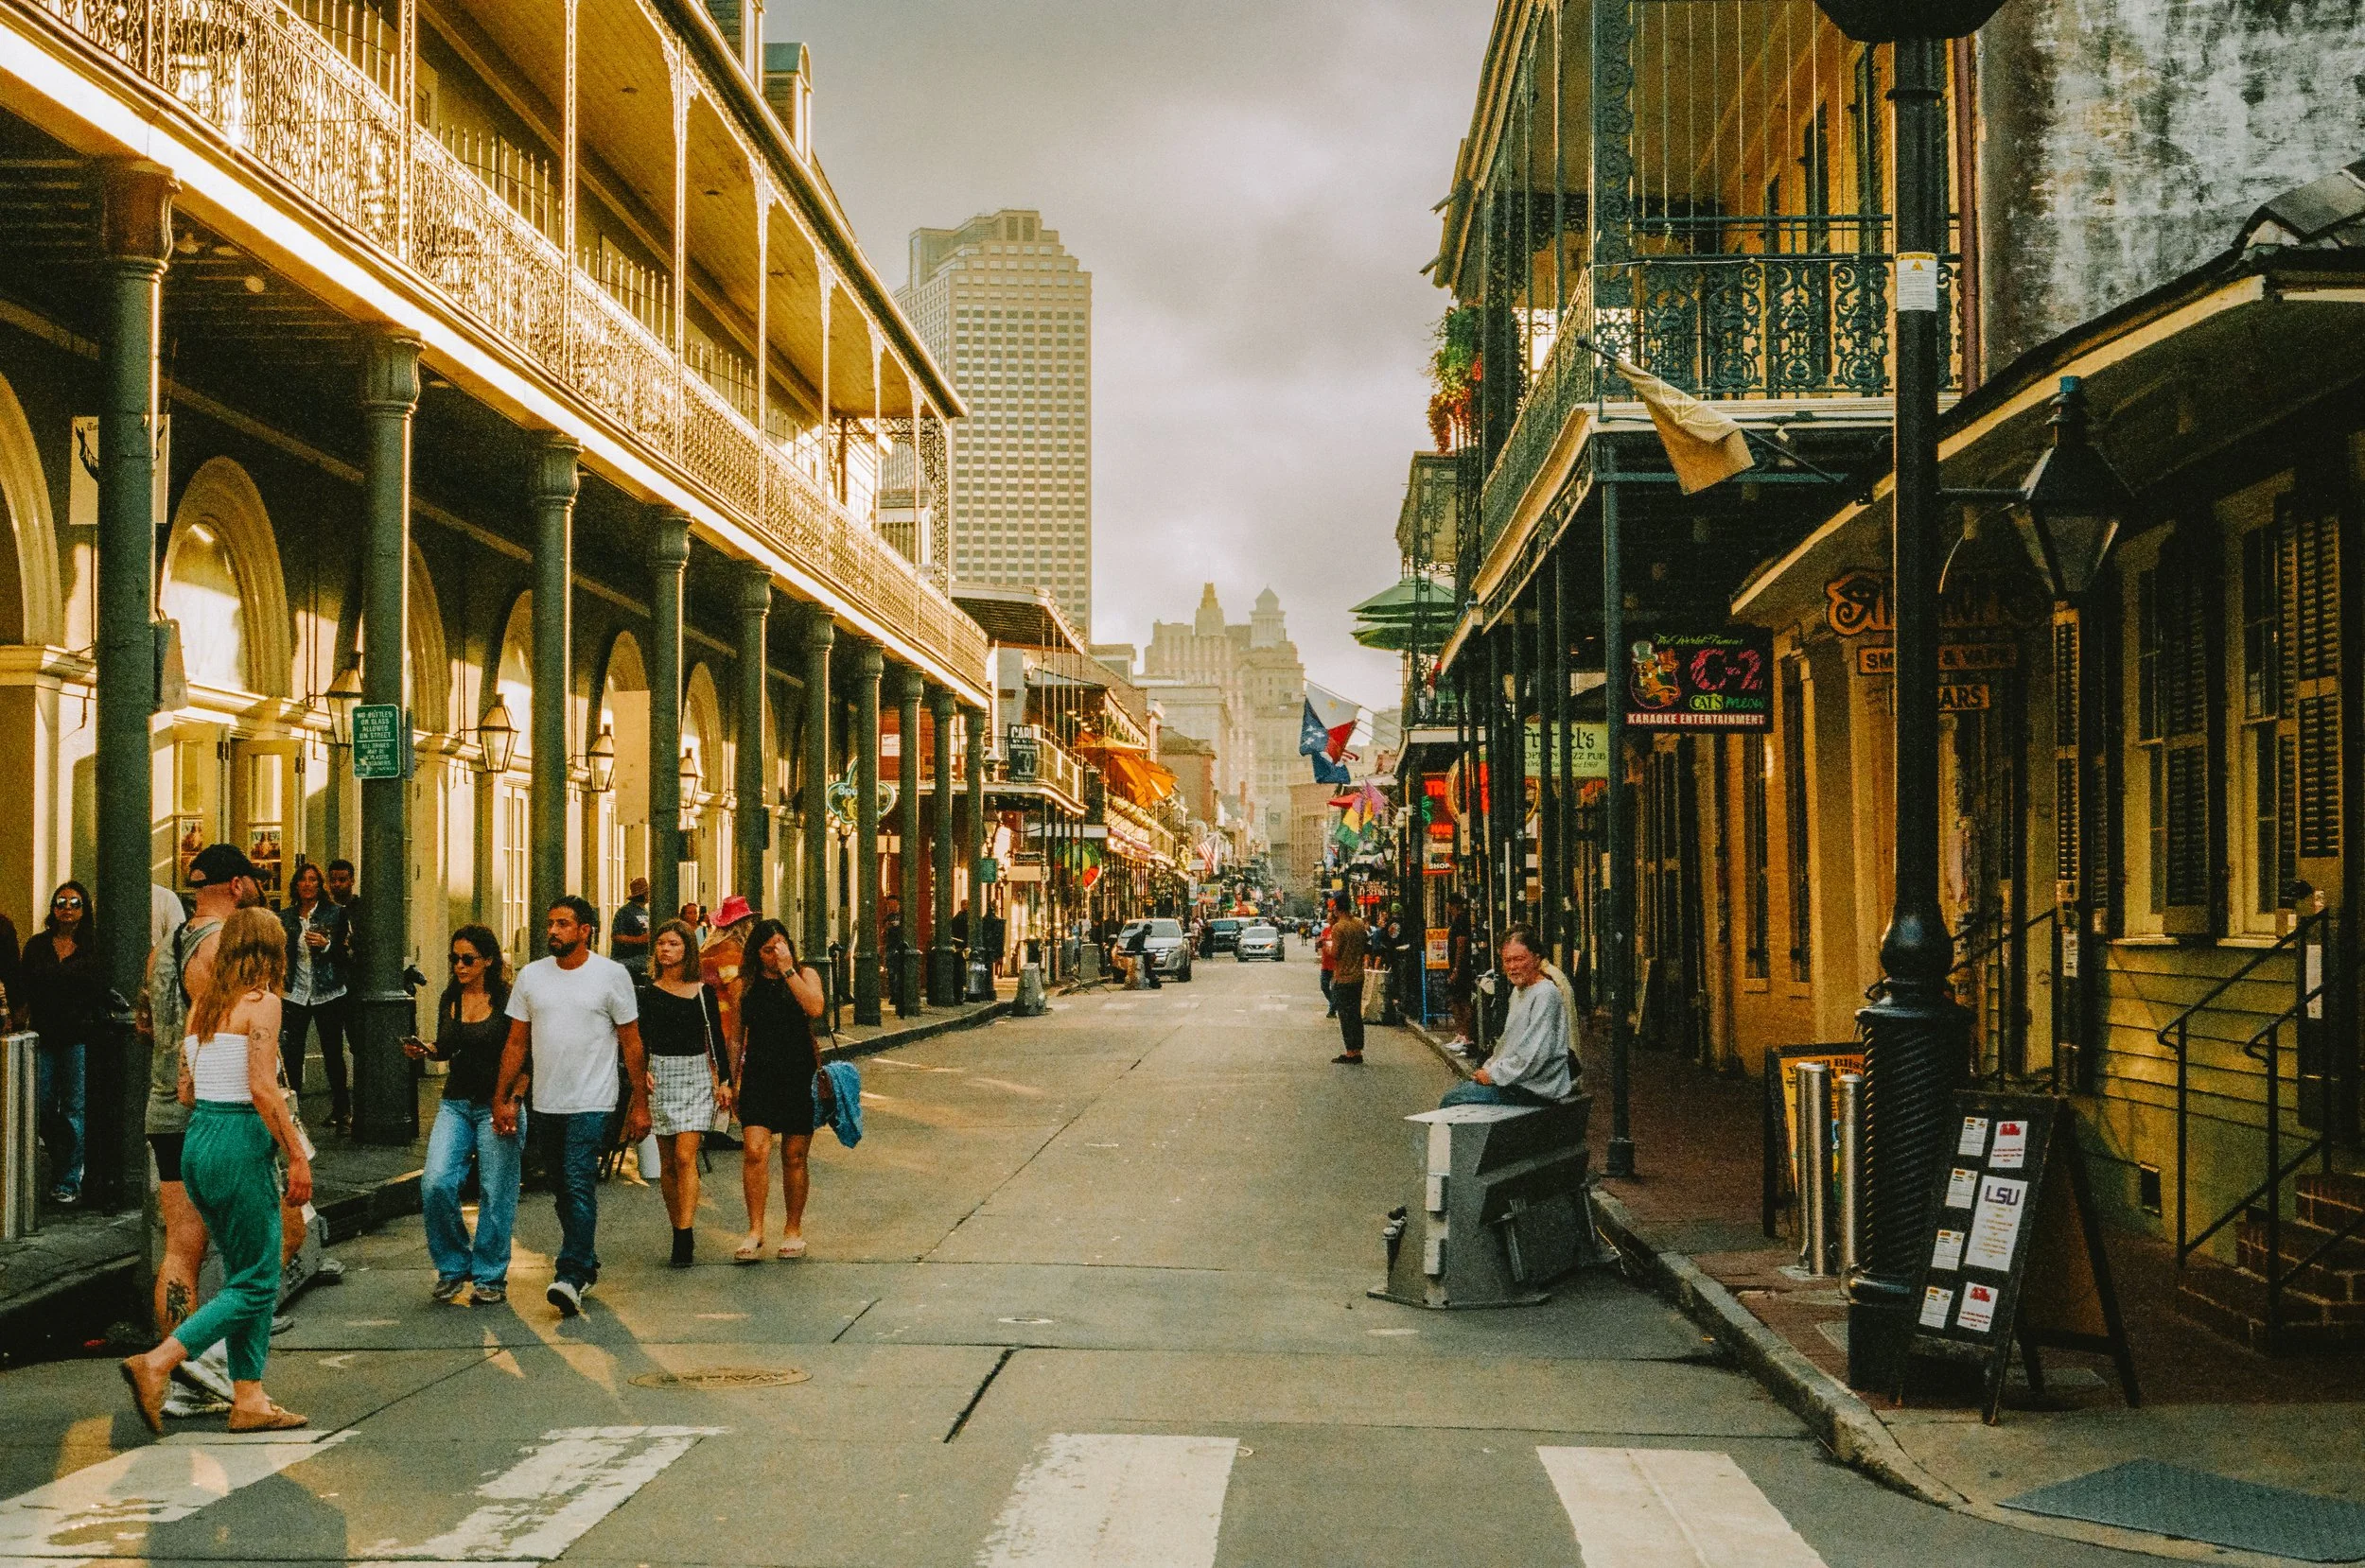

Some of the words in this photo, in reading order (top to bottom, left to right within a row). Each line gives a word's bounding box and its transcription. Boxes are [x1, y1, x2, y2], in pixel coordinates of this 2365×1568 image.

[1628, 714, 1676, 724] KARAOKE
[1679, 714, 1765, 725] ENTERTAINMENT
[1985, 1185, 2021, 1206] LSU
